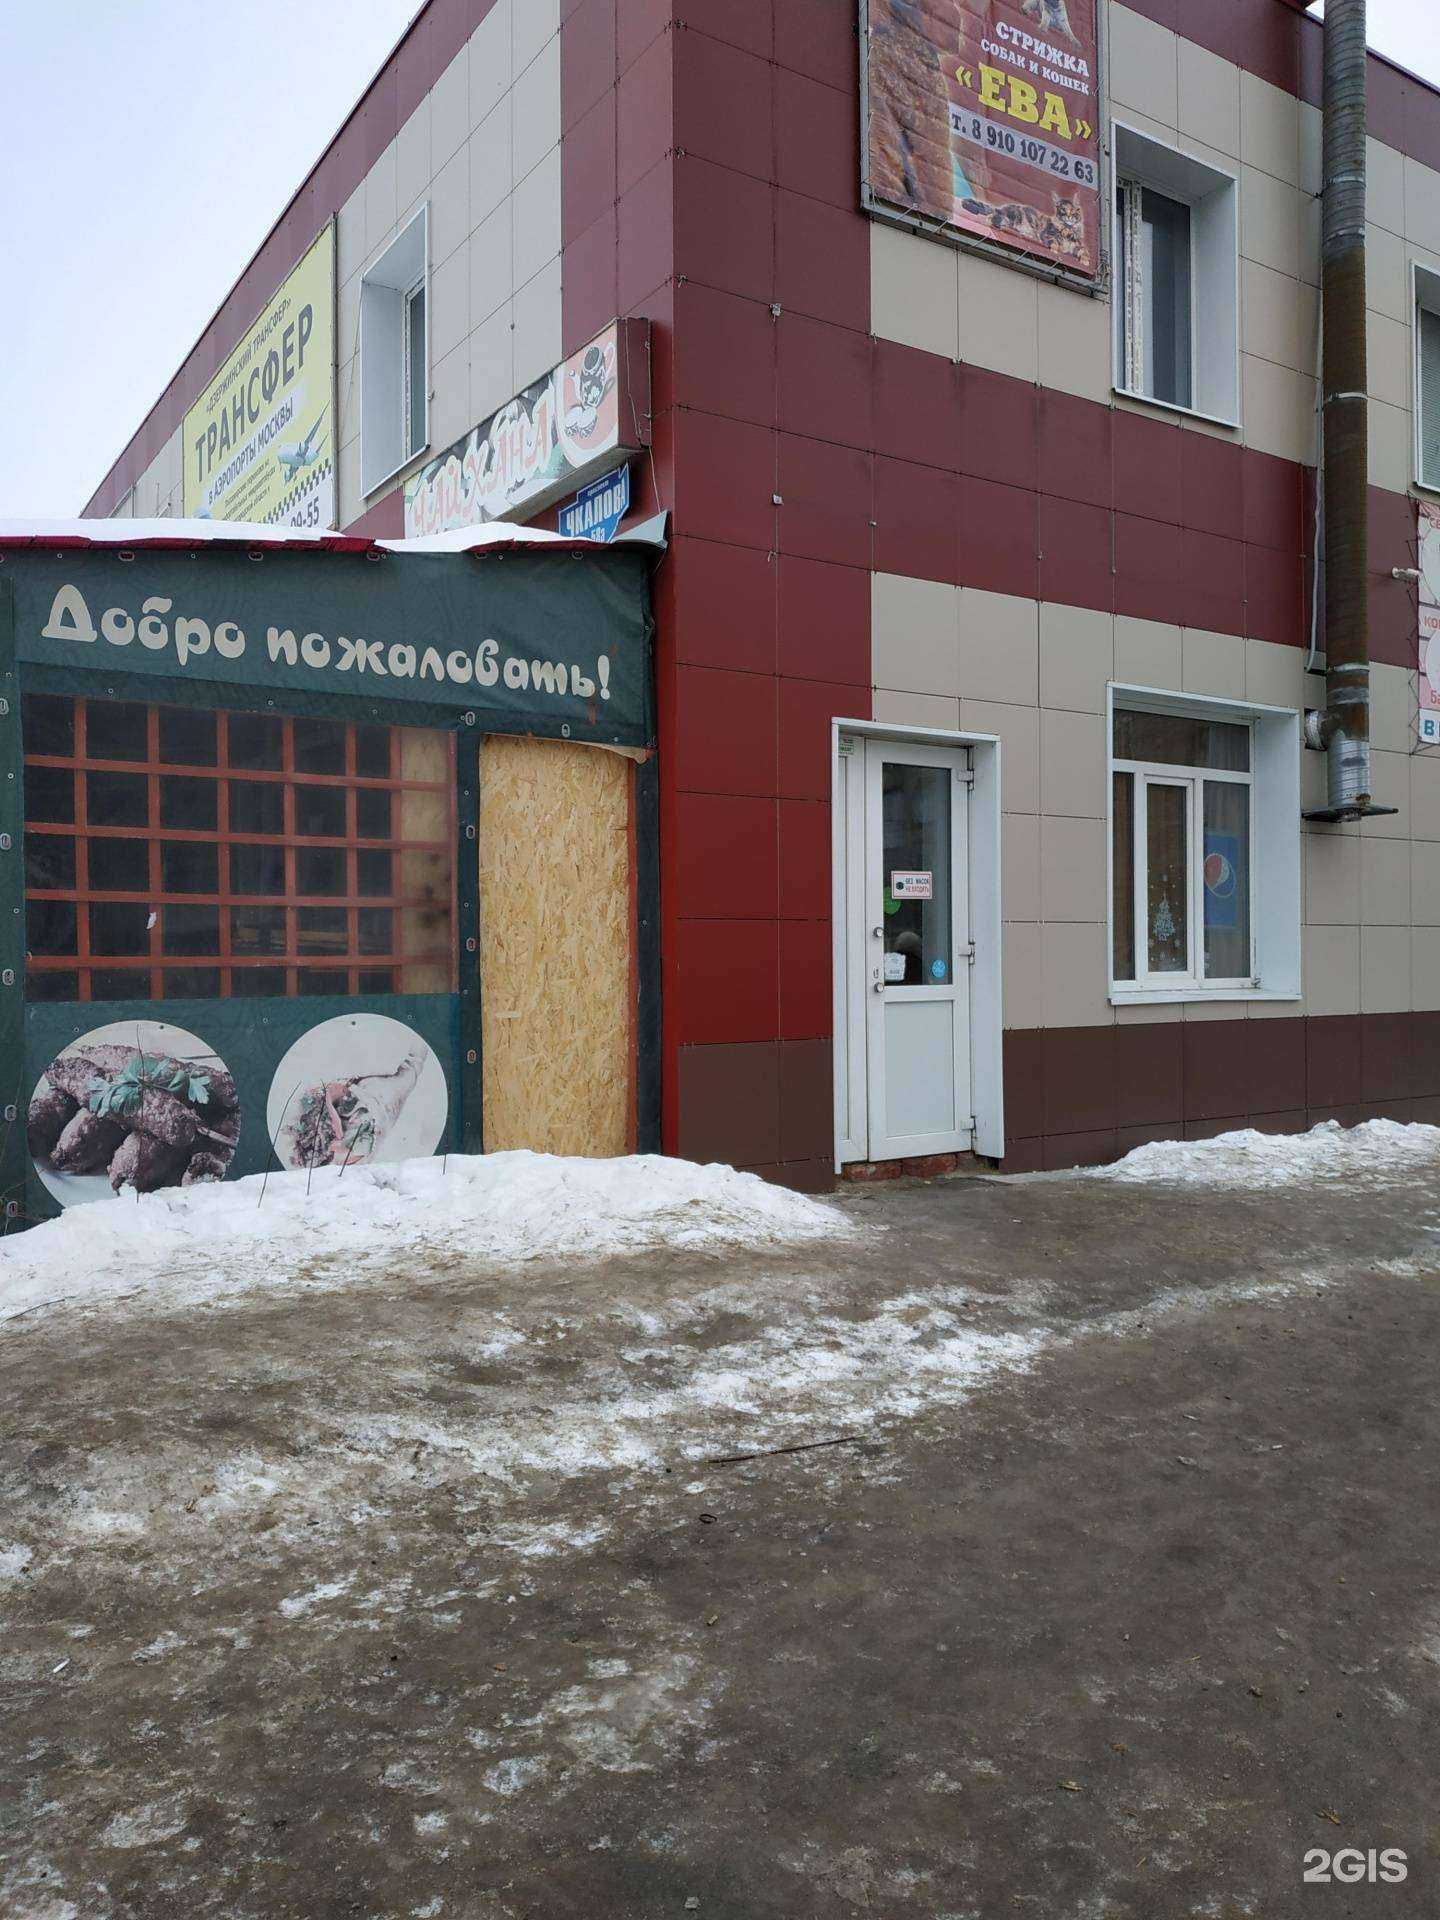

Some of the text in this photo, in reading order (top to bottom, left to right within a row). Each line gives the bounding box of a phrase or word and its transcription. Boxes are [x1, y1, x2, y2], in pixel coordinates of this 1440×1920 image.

[980, 38, 1090, 96] СОБАК И КОШЕК
[995, 21, 1090, 78] СТРИЖКА
[971, 118, 981, 140] 8
[987, 125, 1015, 154] 910
[1020, 138, 1047, 165] 107
[1050, 151, 1069, 176] 22
[1074, 160, 1094, 184] 63
[195, 303, 313, 483] ТРАНСФЕР
[213, 438, 256, 499] АЭРОПОРТЫ
[257, 396, 293, 453] МОСКВЫ
[566, 476, 626, 537] ЧКАЛОВА
[41, 584, 611, 700] Добро пожаловать!
